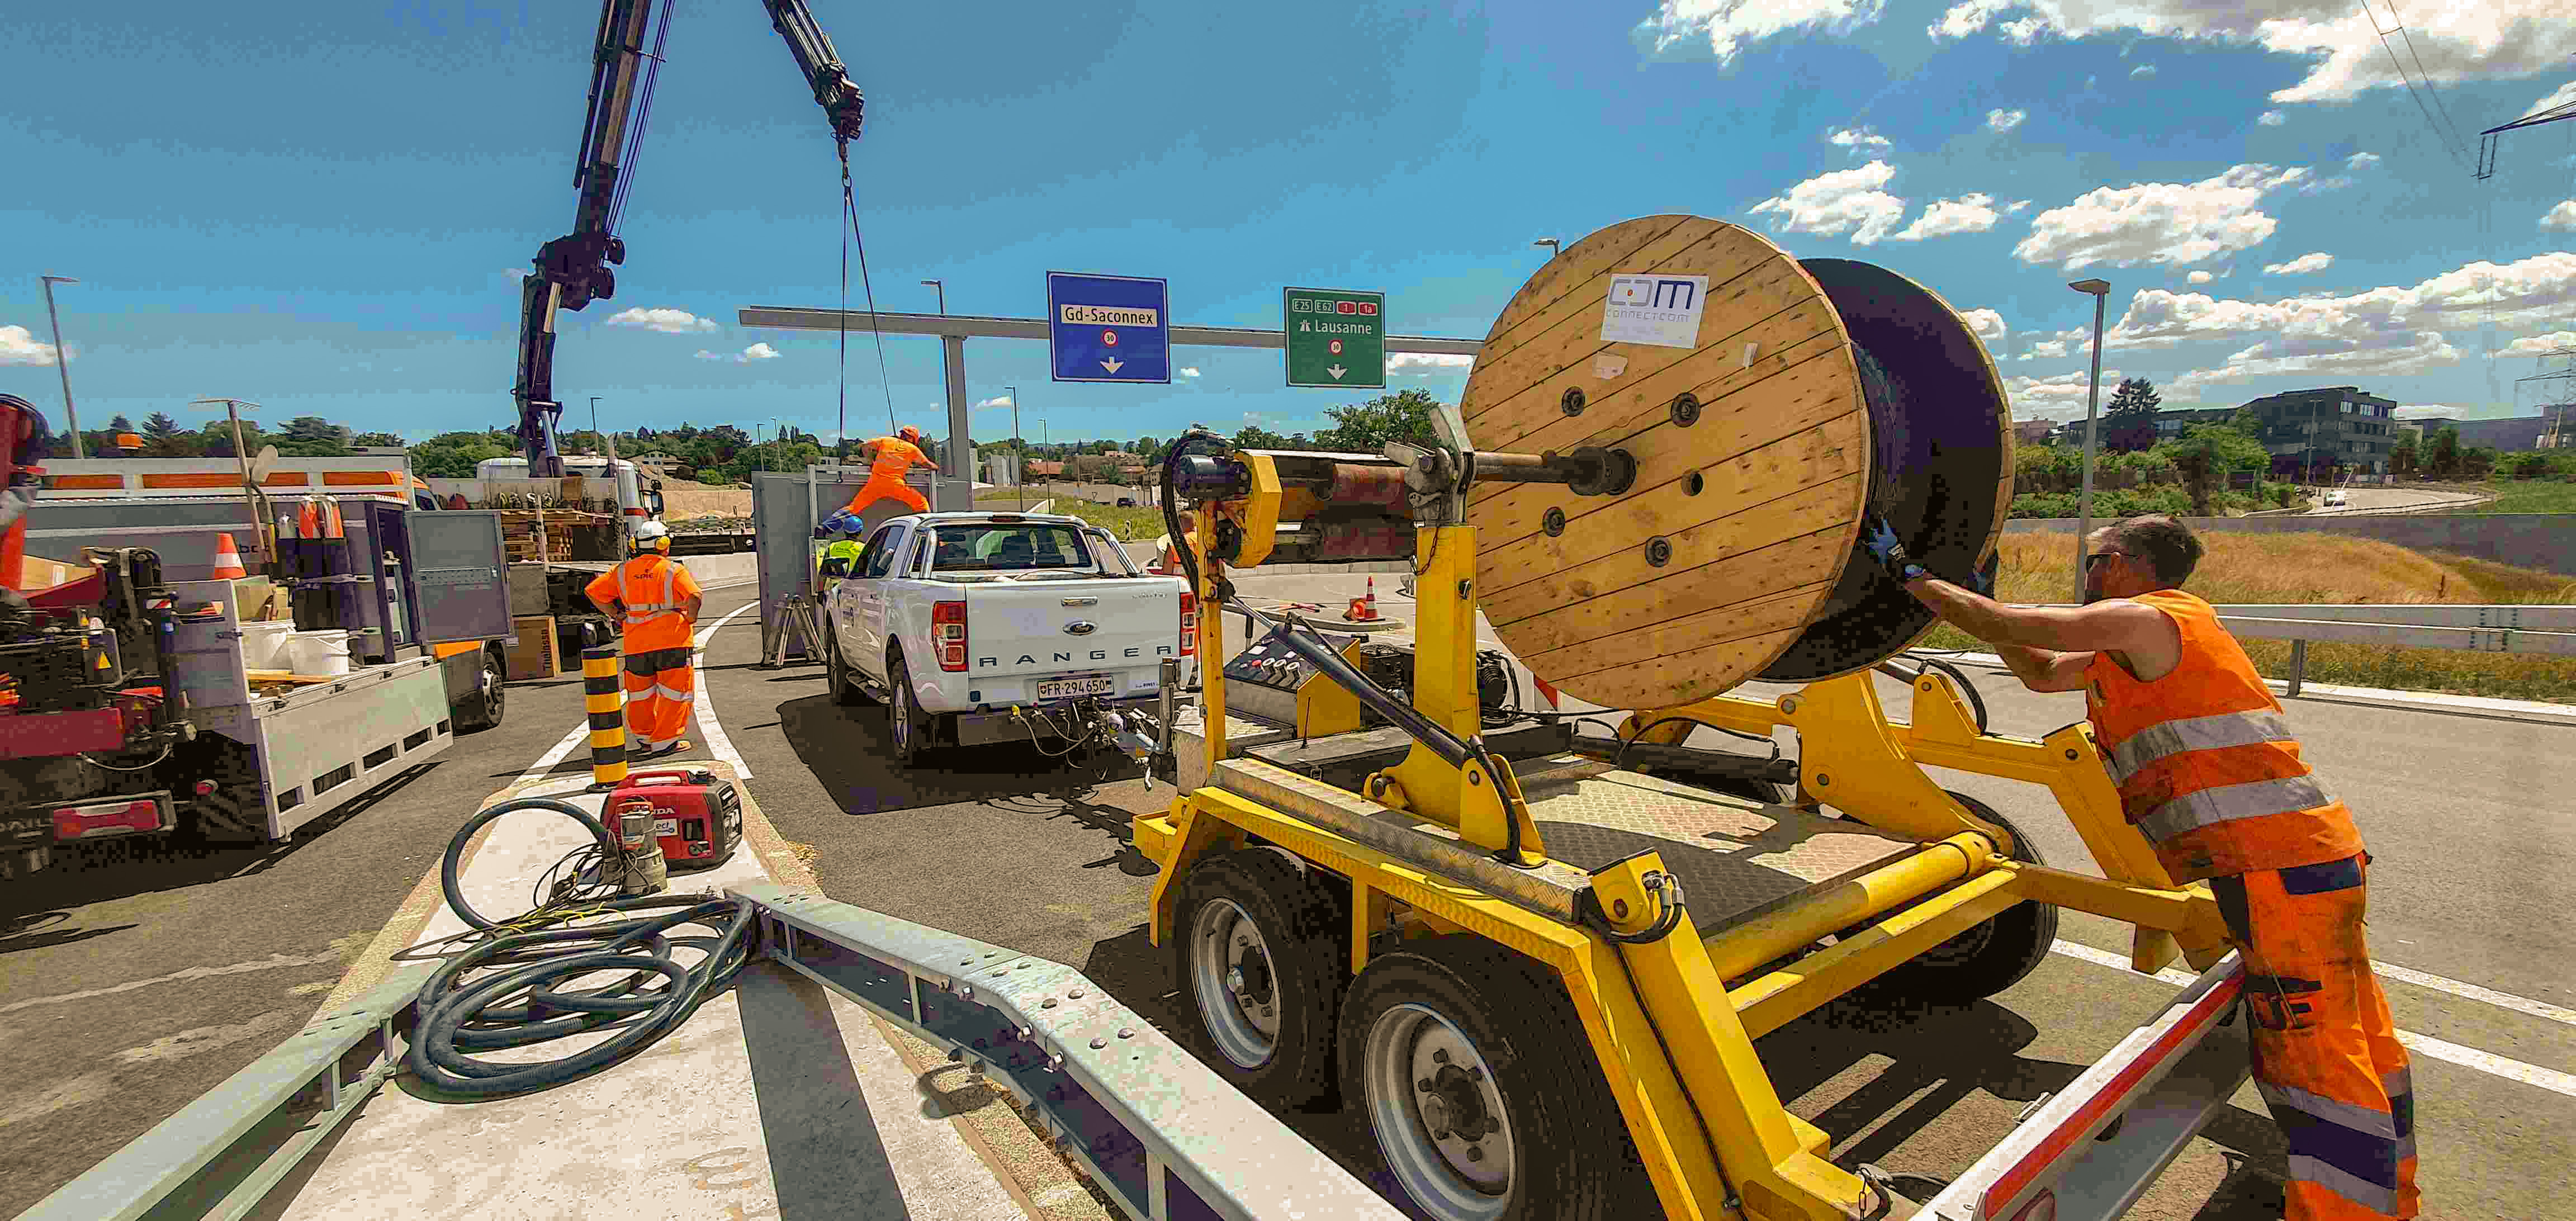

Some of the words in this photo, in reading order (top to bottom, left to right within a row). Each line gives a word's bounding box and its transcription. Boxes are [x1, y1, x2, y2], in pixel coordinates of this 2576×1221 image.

[1065, 307, 1153, 324] Gd-Saconnex
[1315, 319, 1372, 334] Lausanne
[979, 646, 1172, 667] RANGER
